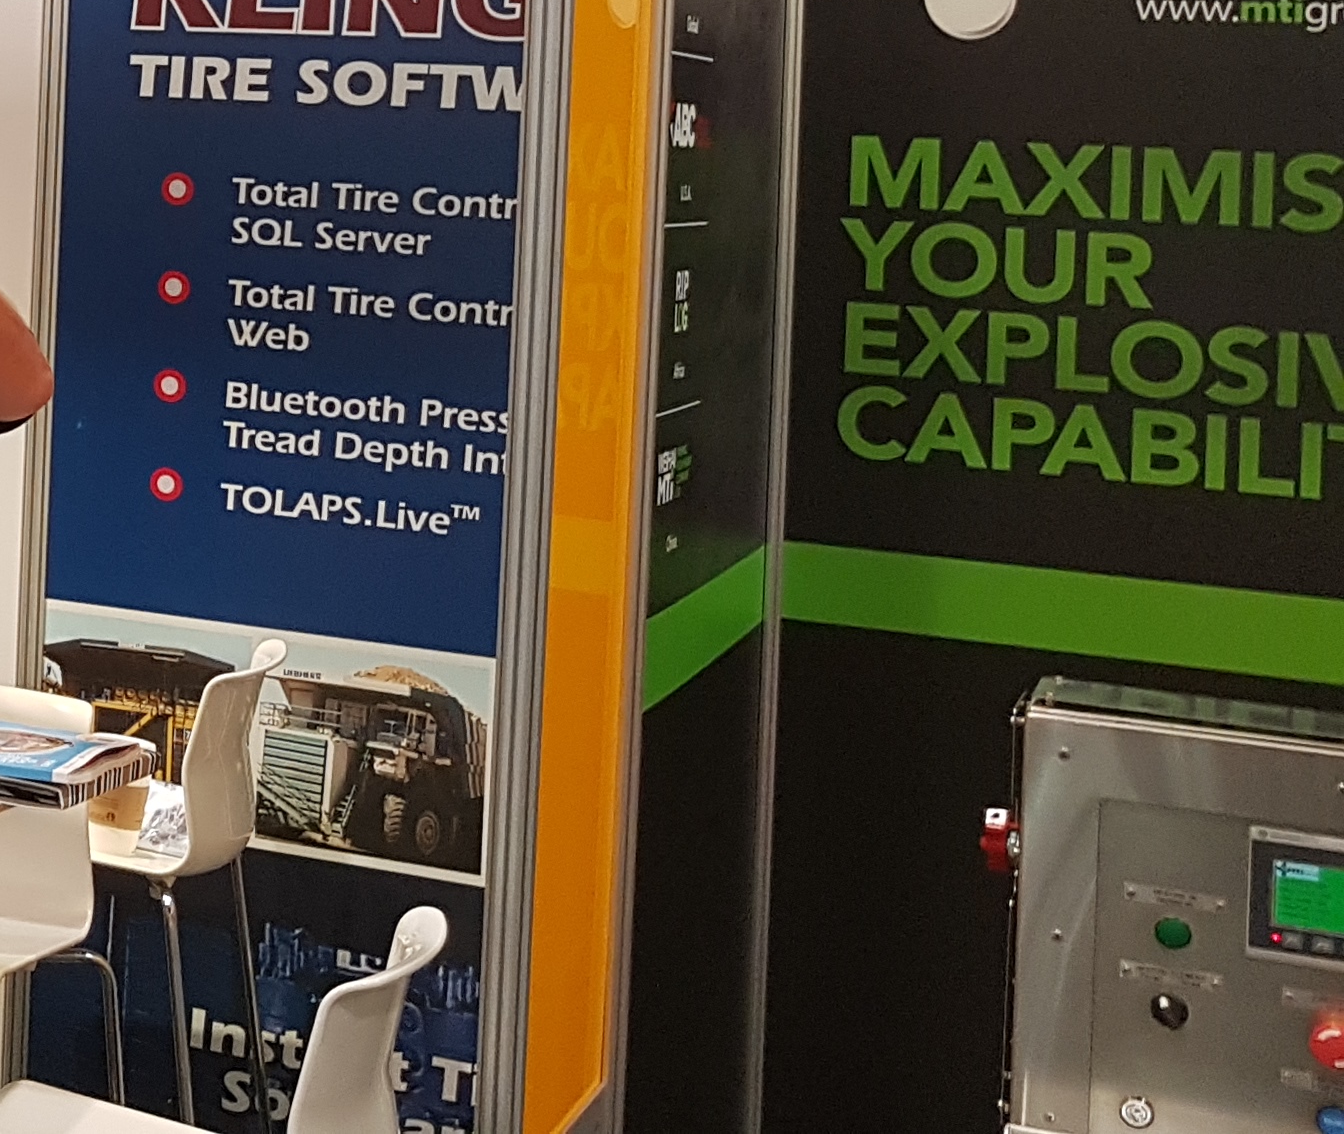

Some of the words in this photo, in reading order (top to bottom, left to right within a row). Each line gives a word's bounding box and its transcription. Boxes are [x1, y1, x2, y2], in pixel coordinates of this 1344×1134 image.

[129, 53, 274, 103] TIRE
[231, 177, 319, 209] Total
[331, 182, 400, 214] Tire
[412, 187, 518, 220] Contr
[848, 134, 1344, 233] MAXIMIS
[230, 217, 303, 248] SQL
[314, 222, 432, 256] Server
[840, 217, 1154, 310] YOUR
[228, 279, 315, 312] Total
[328, 286, 396, 318] Tire
[408, 292, 514, 327] Contr
[227, 318, 310, 352] Web
[225, 381, 406, 425] Bluetooth
[223, 420, 321, 456] Tread
[334, 432, 449, 473] Depth
[837, 385, 1344, 500] CAPABILI
